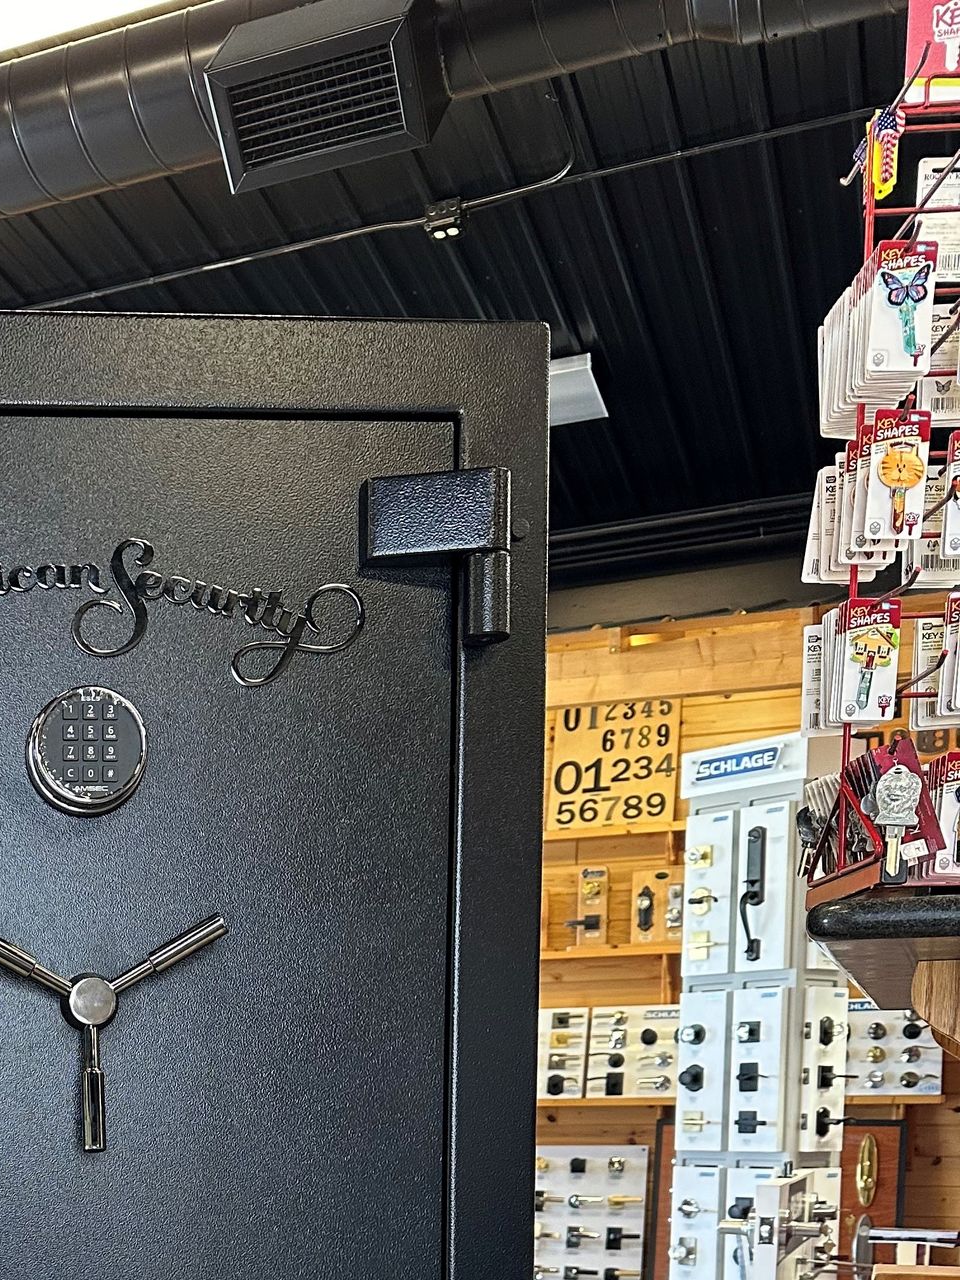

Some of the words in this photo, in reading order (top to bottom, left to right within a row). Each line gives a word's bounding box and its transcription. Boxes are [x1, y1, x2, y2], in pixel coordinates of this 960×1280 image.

[881, 248, 905, 261] KEY
[881, 255, 926, 270] SHAPES
[877, 418, 898, 430] KEY
[876, 425, 919, 440] SHAPES
[71, 538, 365, 687] Security
[850, 606, 870, 618] KEY
[850, 613, 890, 627] SHAPES
[922, 632, 938, 640] KEY
[69, 705, 73, 713] 1
[88, 705, 94, 713] 2
[108, 705, 114, 713] 3
[67, 725, 74, 734] 4
[88, 725, 94, 734] 5
[108, 726, 114, 734] 6
[68, 746, 74, 755] 7
[88, 746, 94, 755] 8
[108, 746, 114, 755] 9
[699, 752, 776, 776] SCHLAGE
[67, 769, 74, 777] C
[88, 769, 94, 777] 0
